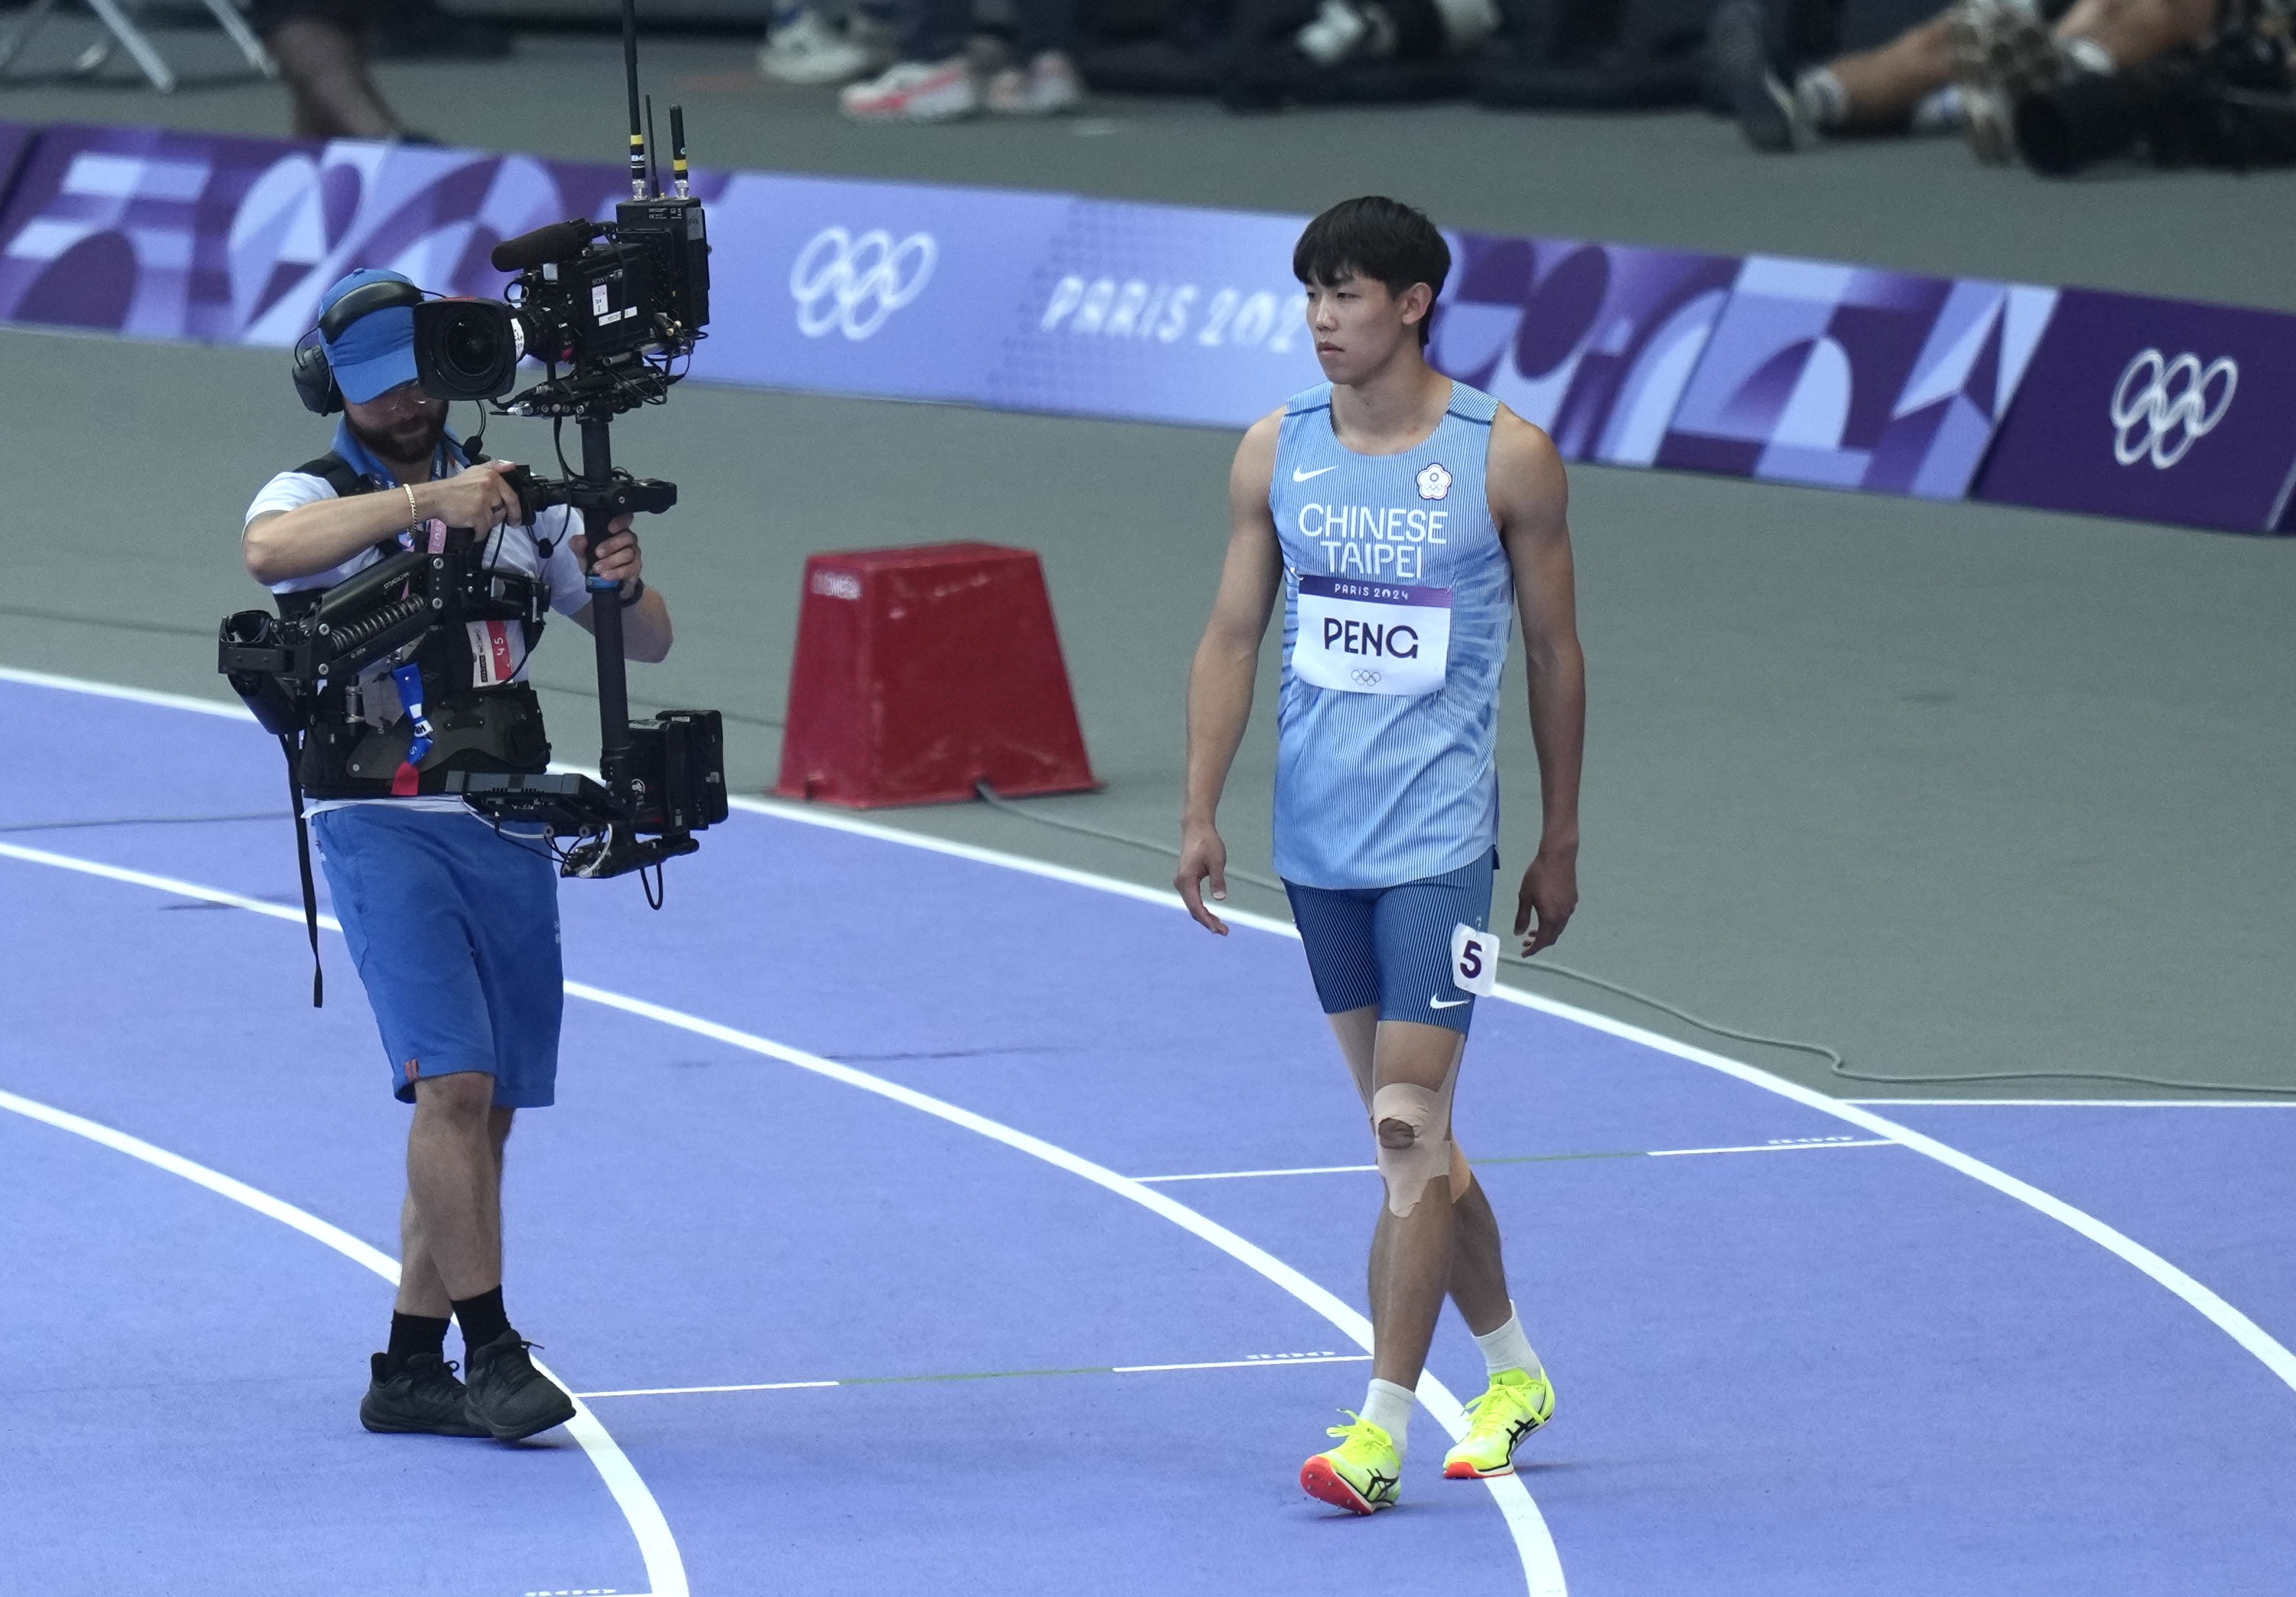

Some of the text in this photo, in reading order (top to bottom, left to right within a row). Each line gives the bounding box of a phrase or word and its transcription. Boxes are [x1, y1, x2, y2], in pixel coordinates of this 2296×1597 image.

[592, 274, 608, 285] SONY
[1040, 275, 1308, 354] PARIS 202
[1298, 503, 1449, 544] CHINESE
[1320, 541, 1422, 578] TAIPEI
[1334, 583, 1409, 600] PARIS 2024
[1323, 617, 1419, 660] PENG
[1460, 940, 1483, 979] 5
